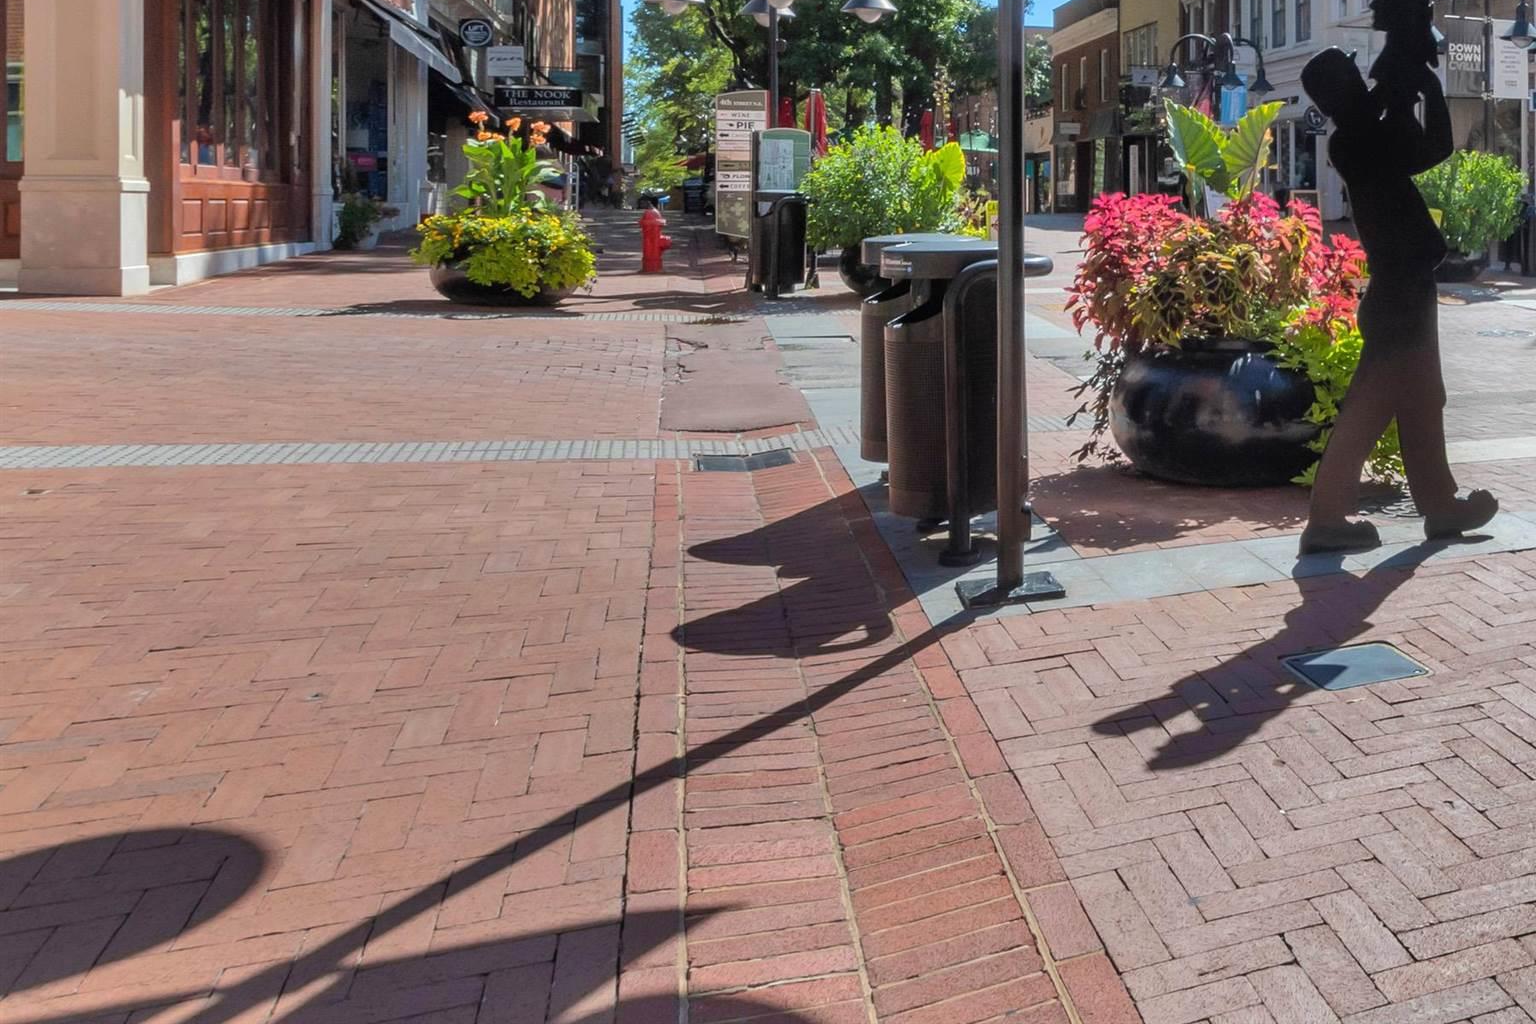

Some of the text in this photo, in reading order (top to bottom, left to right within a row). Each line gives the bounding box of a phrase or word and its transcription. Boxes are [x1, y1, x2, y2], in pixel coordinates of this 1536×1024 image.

[1448, 43, 1481, 53] DOWN
[1448, 52, 1481, 62] TOWN
[503, 89, 571, 99] THE NOOK
[510, 98, 565, 106] Restaurant
[736, 121, 755, 129] PIE
